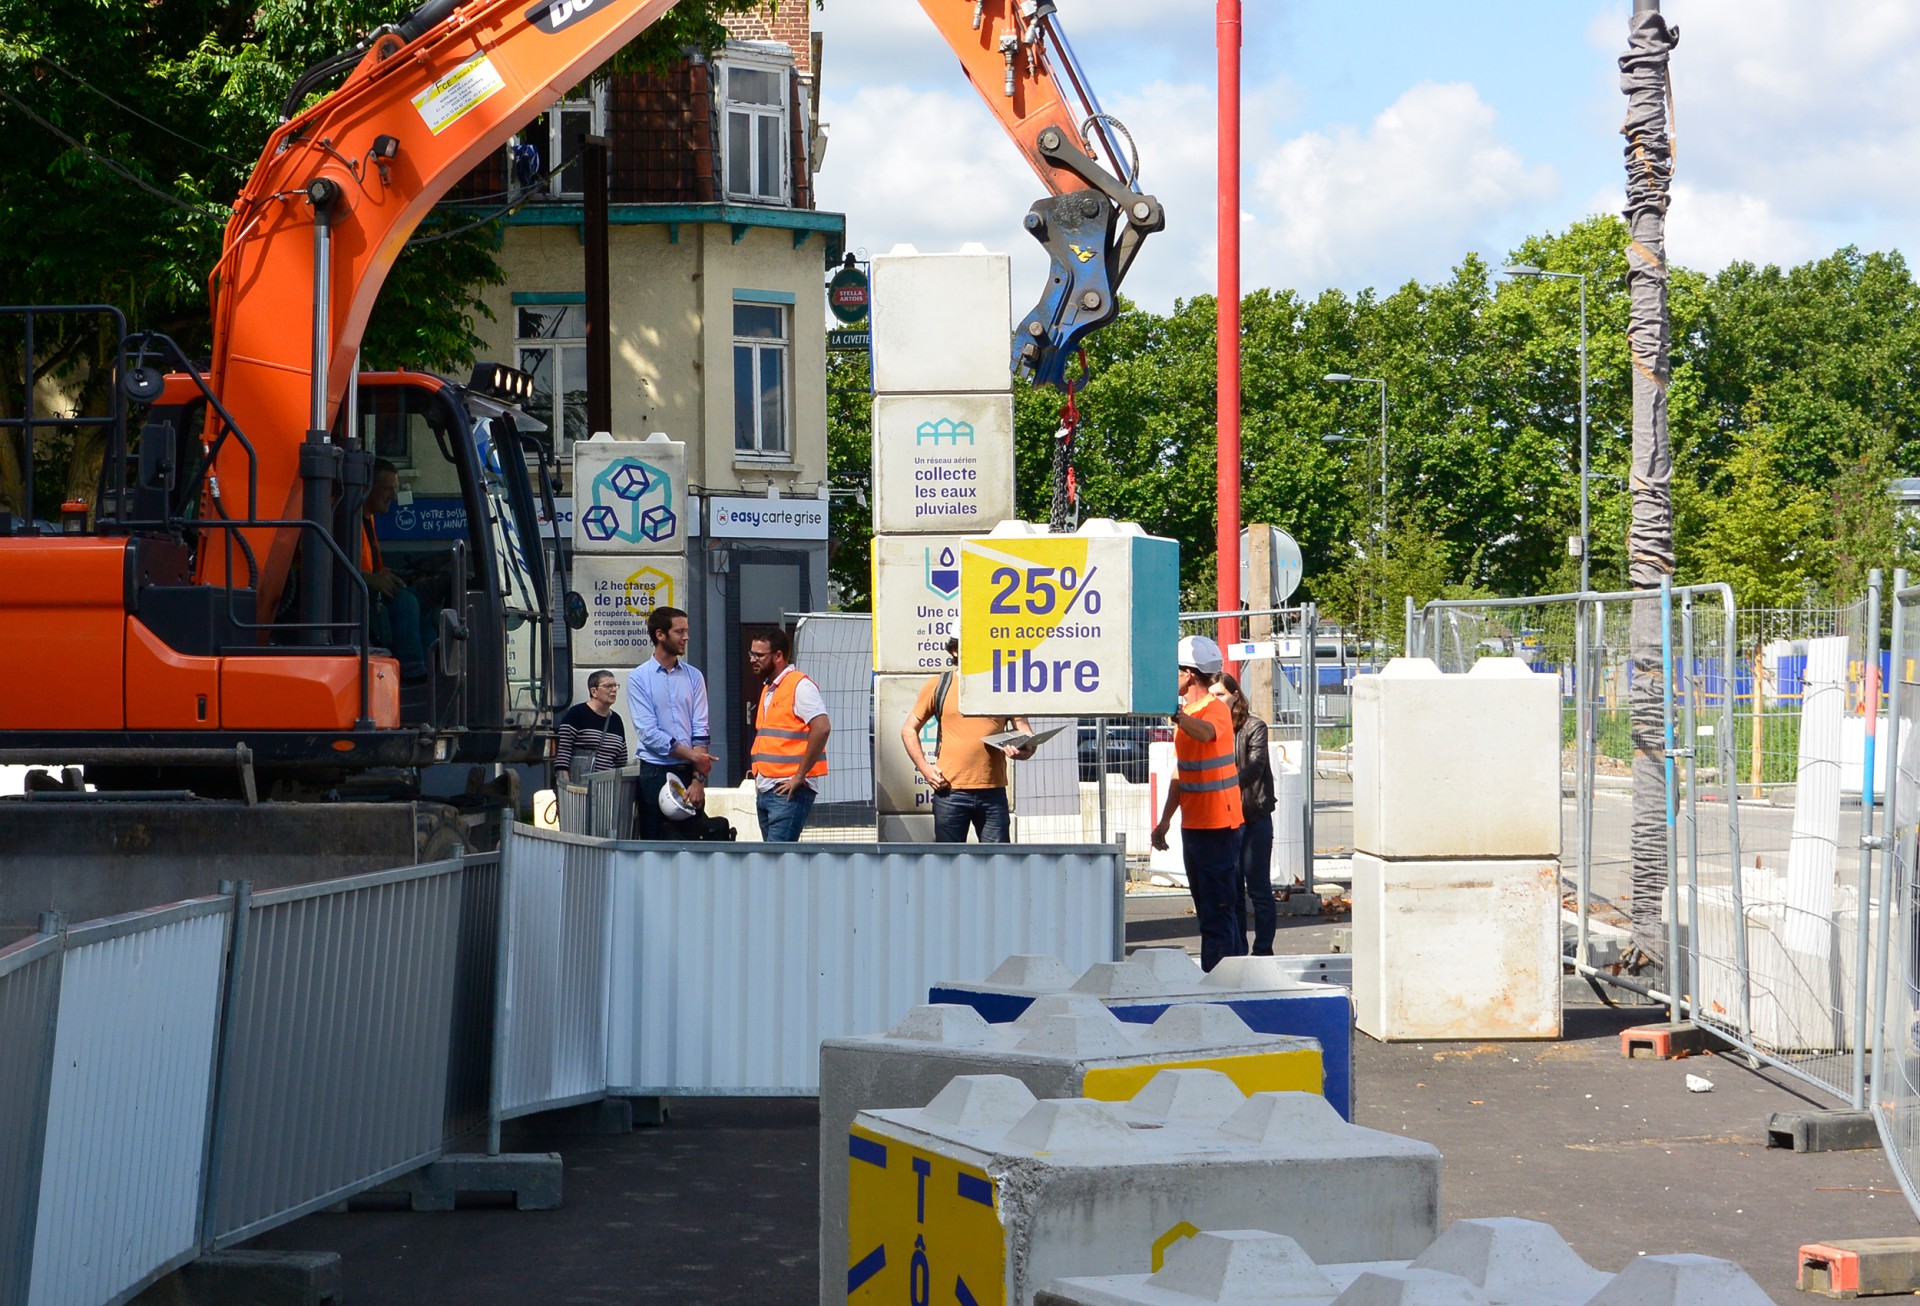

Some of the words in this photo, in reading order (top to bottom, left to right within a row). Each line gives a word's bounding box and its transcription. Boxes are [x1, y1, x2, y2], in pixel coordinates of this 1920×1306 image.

[832, 335, 841, 344] LA
[843, 335, 870, 344] CIVETTE
[915, 467, 977, 480] collecte
[915, 485, 936, 498] les
[941, 487, 976, 498] eaux
[915, 502, 977, 517] pluviales
[731, 511, 760, 527] easy
[761, 510, 792, 524] carte
[794, 511, 821, 527] grise
[423, 521, 434, 530] EN
[436, 521, 441, 531] 5
[611, 580, 656, 591] hectares
[990, 566, 1101, 615] 25%
[594, 593, 611, 606] de
[615, 592, 656, 608] pavés
[917, 606, 943, 618] Une
[603, 619, 630, 627] reposés
[990, 626, 1010, 638] en
[1015, 622, 1101, 638] accession
[918, 657, 942, 667] ces
[992, 649, 1099, 692] libre
